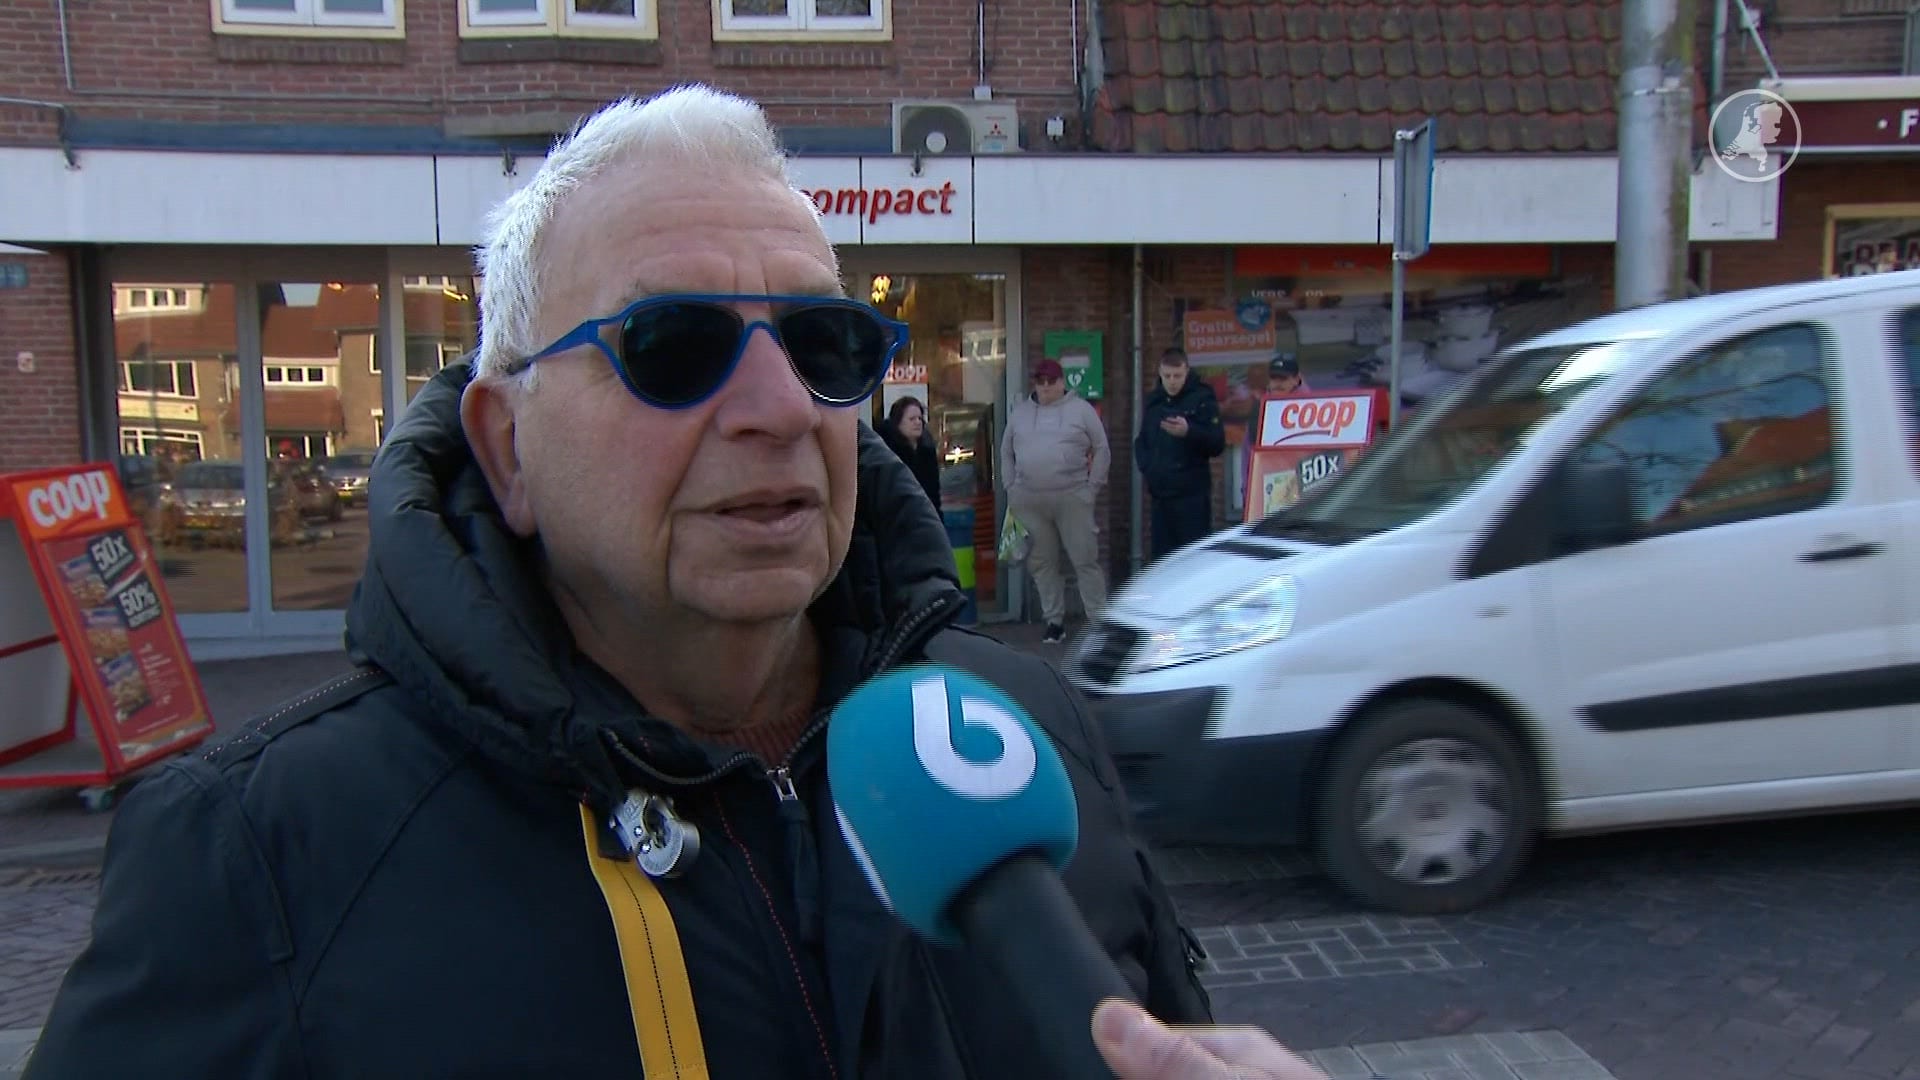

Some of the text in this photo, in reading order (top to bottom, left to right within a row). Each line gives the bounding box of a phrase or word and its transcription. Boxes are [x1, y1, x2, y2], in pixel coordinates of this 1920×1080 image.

[1188, 319, 1235, 334] Gratis
[1280, 400, 1356, 438] coop
[1302, 454, 1339, 484] 50x
[28, 470, 111, 528] coop
[91, 536, 129, 571] 50x
